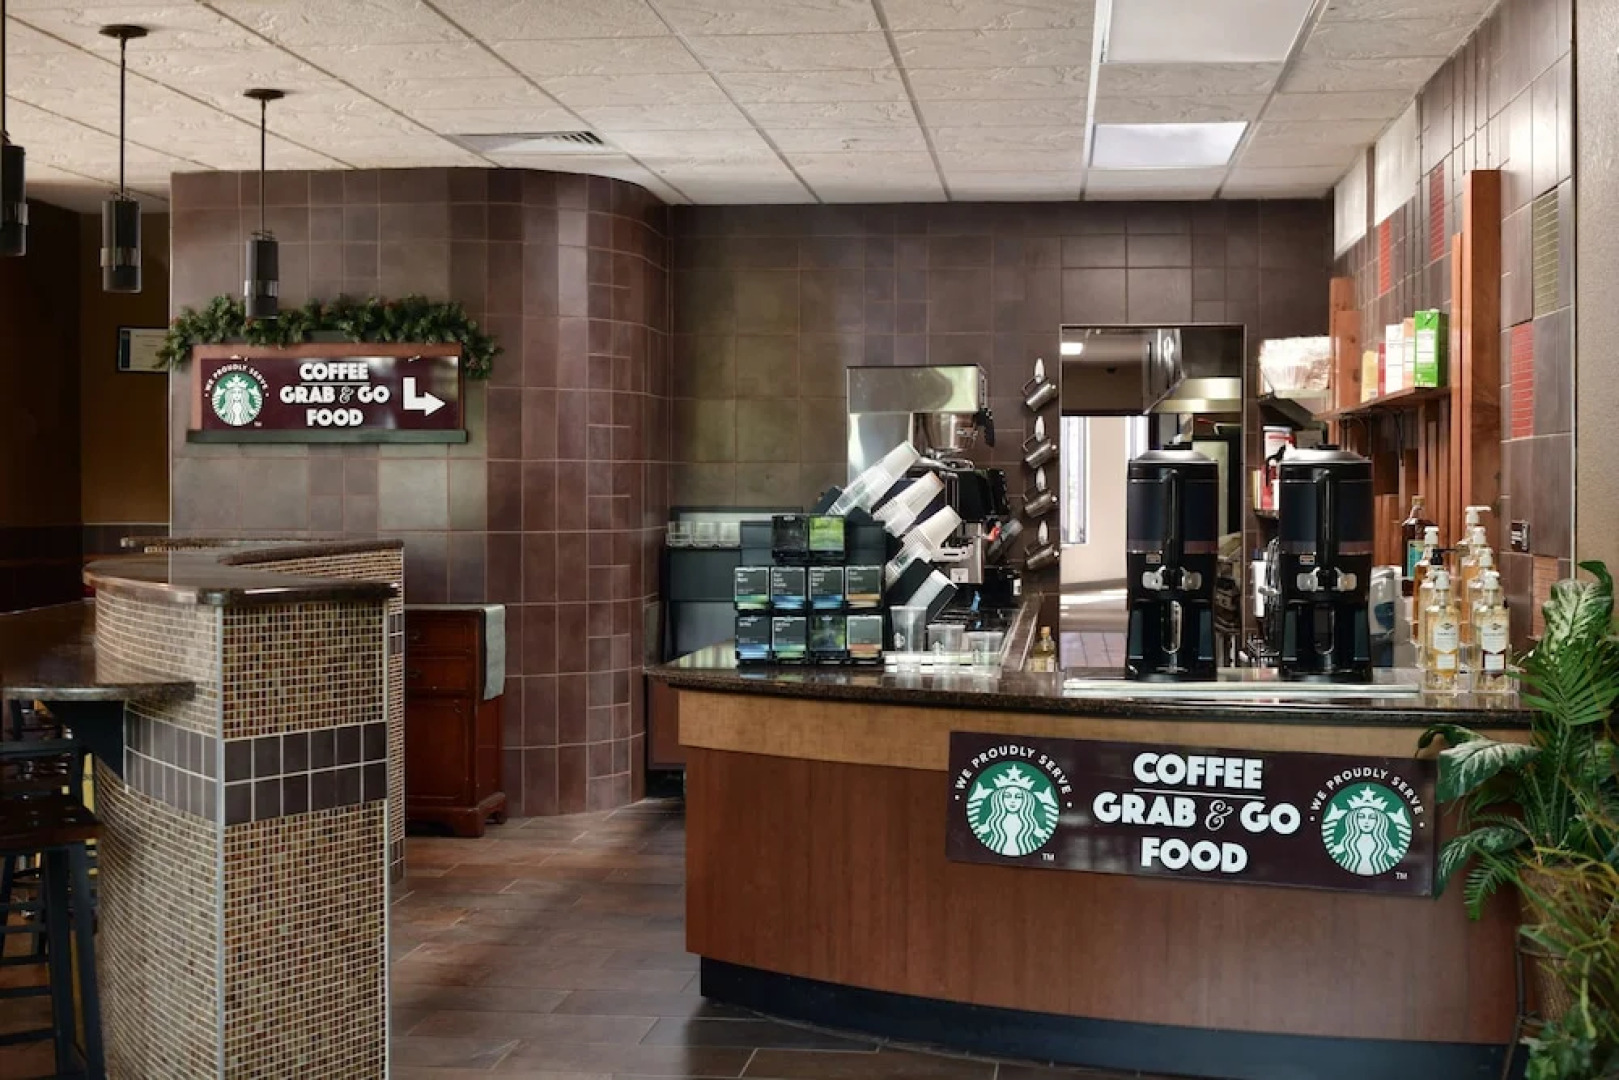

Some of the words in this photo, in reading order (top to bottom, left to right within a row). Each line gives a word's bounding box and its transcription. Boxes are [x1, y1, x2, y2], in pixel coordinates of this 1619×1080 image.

[205, 379, 215, 390] WE
[212, 364, 248, 379] PROUDLY
[248, 367, 268, 389] SERVE
[300, 363, 369, 380] COFFEE
[280, 386, 336, 404] GRAB
[339, 386, 355, 403] &
[357, 386, 390, 404] GO
[306, 409, 363, 427] FOOD
[955, 768, 973, 790] WE
[970, 744, 1036, 768] PROUDLY
[1038, 754, 1073, 794] SERVE
[1133, 752, 1263, 790] COFFEE
[1310, 789, 1327, 810] WE
[1325, 767, 1388, 790] PROUDLY
[1391, 776, 1424, 815] SERVE
[1092, 792, 1196, 827] GRAB
[1205, 798, 1234, 831] &
[1239, 801, 1301, 835] GO
[1140, 837, 1247, 874] FOOD
